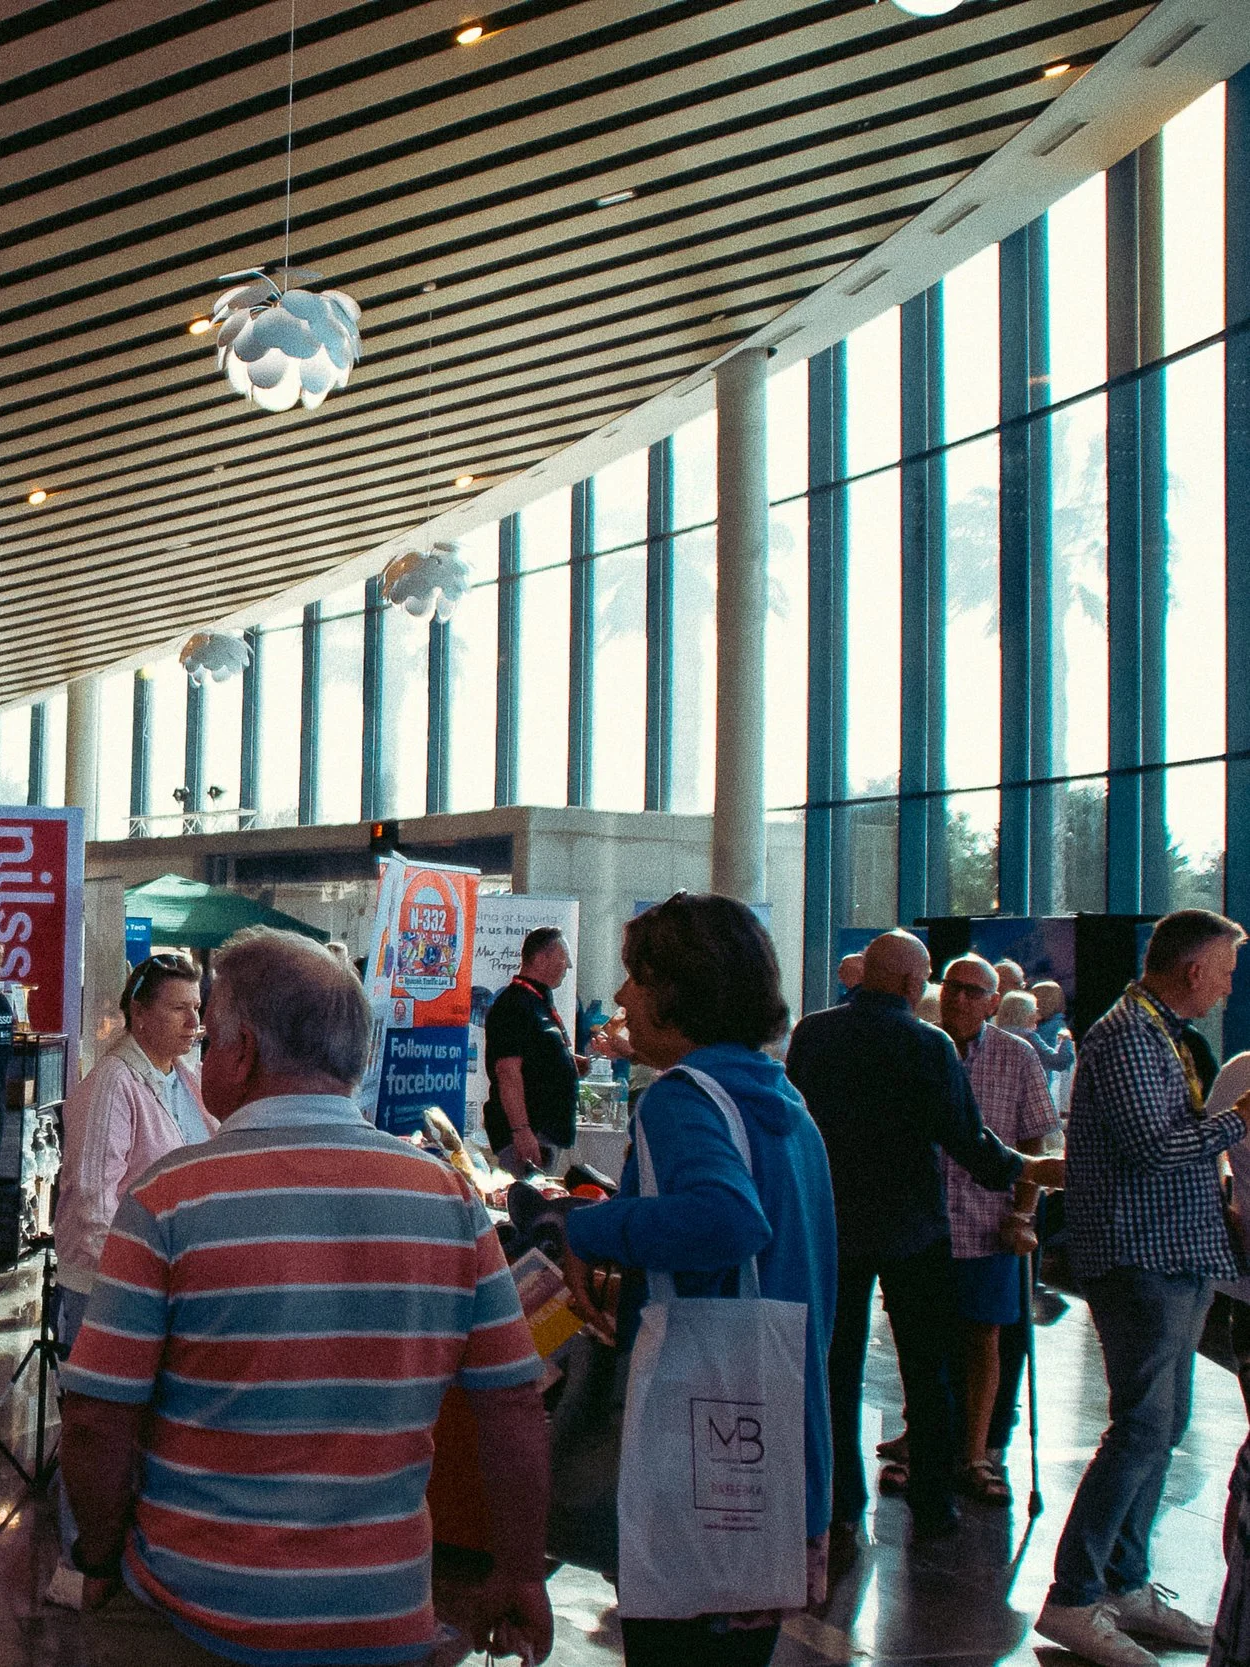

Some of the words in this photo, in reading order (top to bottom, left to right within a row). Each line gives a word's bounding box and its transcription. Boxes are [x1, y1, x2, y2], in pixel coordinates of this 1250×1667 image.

[410, 907, 448, 932] N-332
[501, 914, 514, 922] or
[475, 945, 497, 958] Mar
[390, 1037, 433, 1059] Follow
[435, 1046, 447, 1059] us
[449, 1046, 462, 1060] on
[386, 1063, 462, 1096] facebook
[708, 1416, 765, 1464] MB
